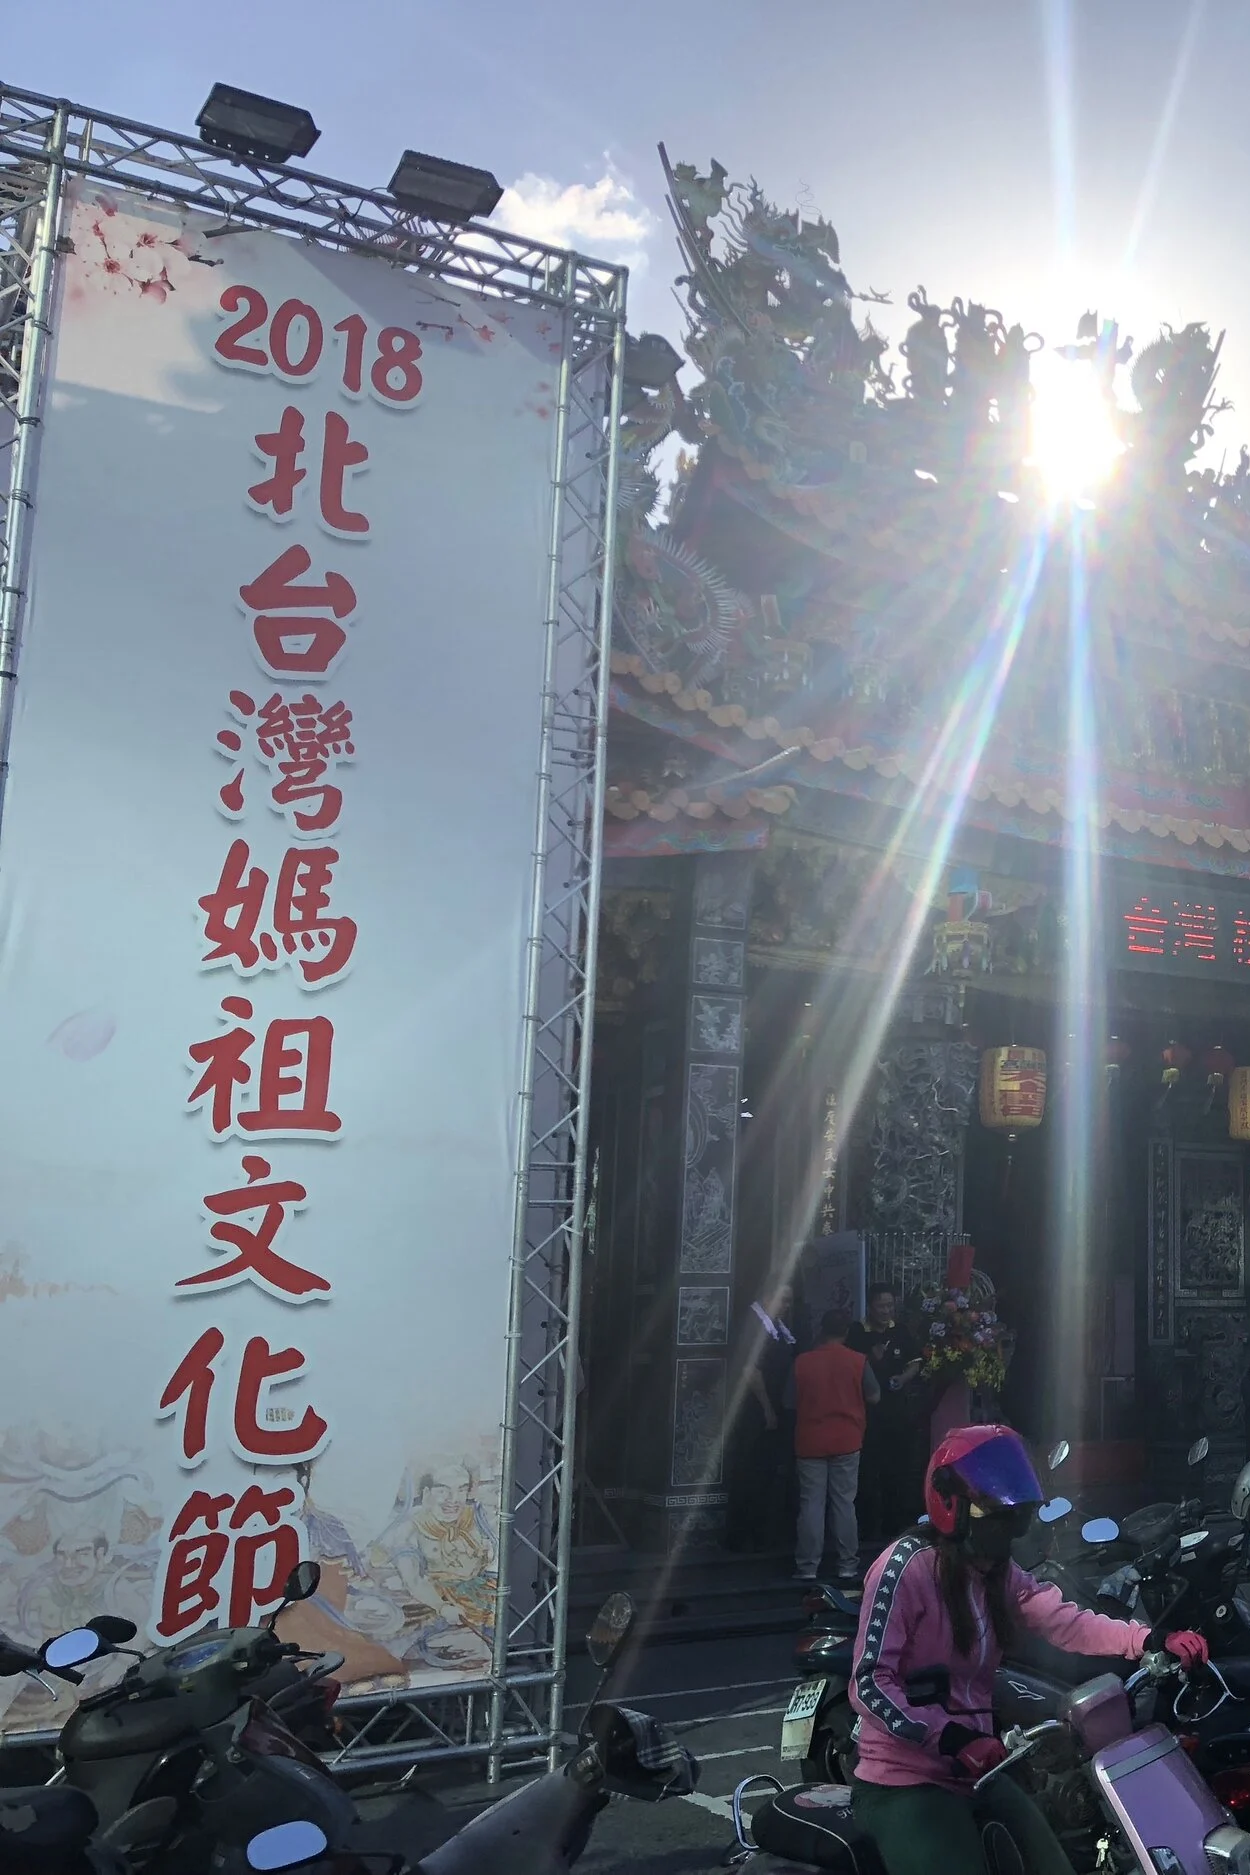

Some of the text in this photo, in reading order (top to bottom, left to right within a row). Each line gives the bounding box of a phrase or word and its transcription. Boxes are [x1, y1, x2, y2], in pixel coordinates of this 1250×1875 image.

[214, 284, 424, 402] 2018
[1123, 896, 1218, 961] 台灣
[156, 405, 371, 1638] 北台灣媽祖文化節
